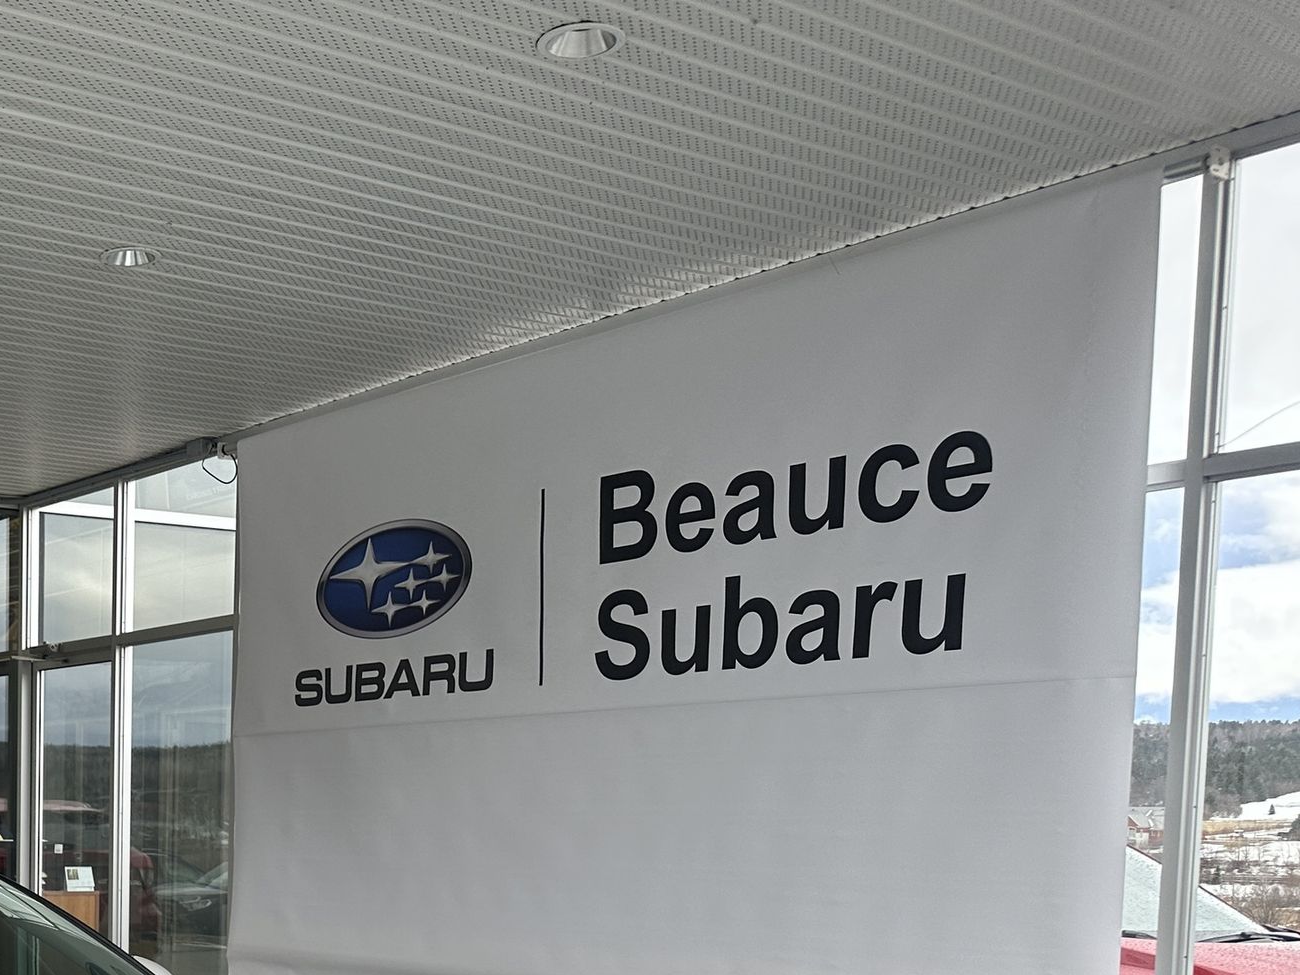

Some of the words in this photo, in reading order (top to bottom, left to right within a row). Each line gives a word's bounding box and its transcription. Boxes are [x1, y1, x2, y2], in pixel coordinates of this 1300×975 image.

[600, 431, 993, 565] Beauce
[295, 649, 495, 707] SUBARU
[594, 573, 966, 680] Subaru
